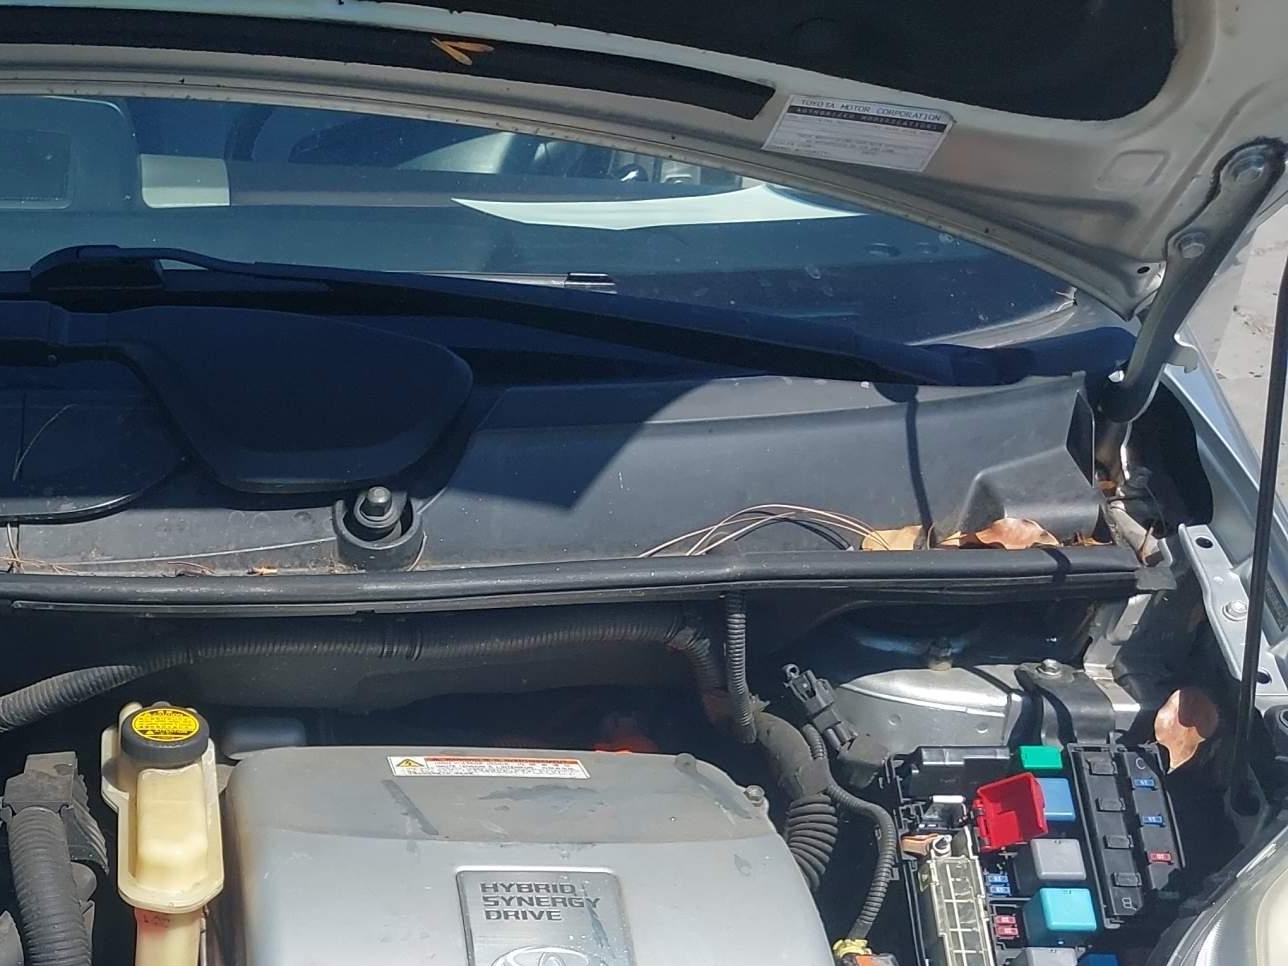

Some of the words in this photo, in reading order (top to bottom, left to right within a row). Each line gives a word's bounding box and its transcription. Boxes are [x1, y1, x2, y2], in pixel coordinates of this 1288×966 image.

[801, 99, 835, 109] TOYOTA
[840, 103, 871, 113] MOTOR
[876, 107, 942, 121] CORPORATION
[480, 882, 576, 894] HYBRID
[482, 896, 600, 908] SYNERGY
[485, 910, 562, 921] DRIVE
